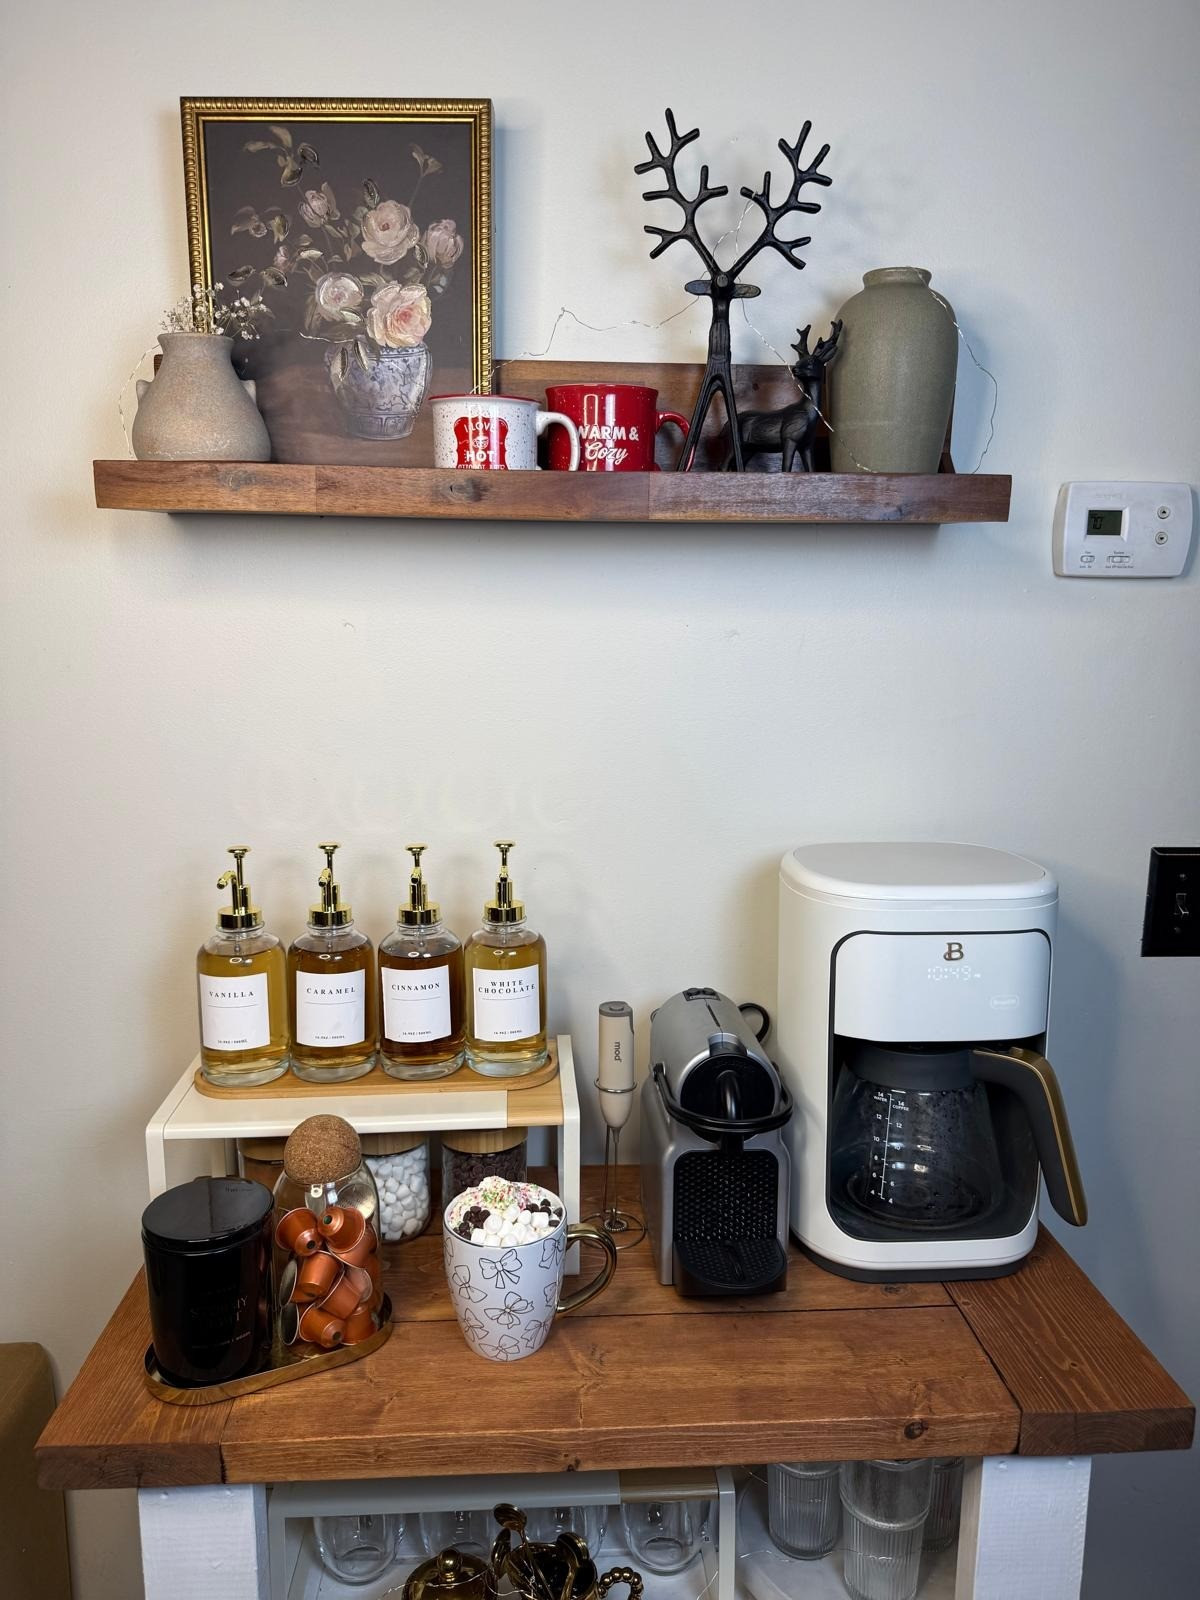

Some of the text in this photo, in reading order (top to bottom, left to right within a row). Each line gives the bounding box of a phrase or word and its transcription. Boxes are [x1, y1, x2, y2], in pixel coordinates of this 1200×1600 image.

[464, 424, 469, 433] I
[577, 424, 640, 441] WARM &
[466, 450, 495, 462] HOT
[585, 441, 629, 465] Cozy
[391, 982, 440, 991] CINNAMON
[490, 979, 524, 988] WHITE
[306, 987, 356, 995] CARAMEL
[478, 983, 536, 994] CHOCOLATE
[209, 990, 255, 998] VANILLA
